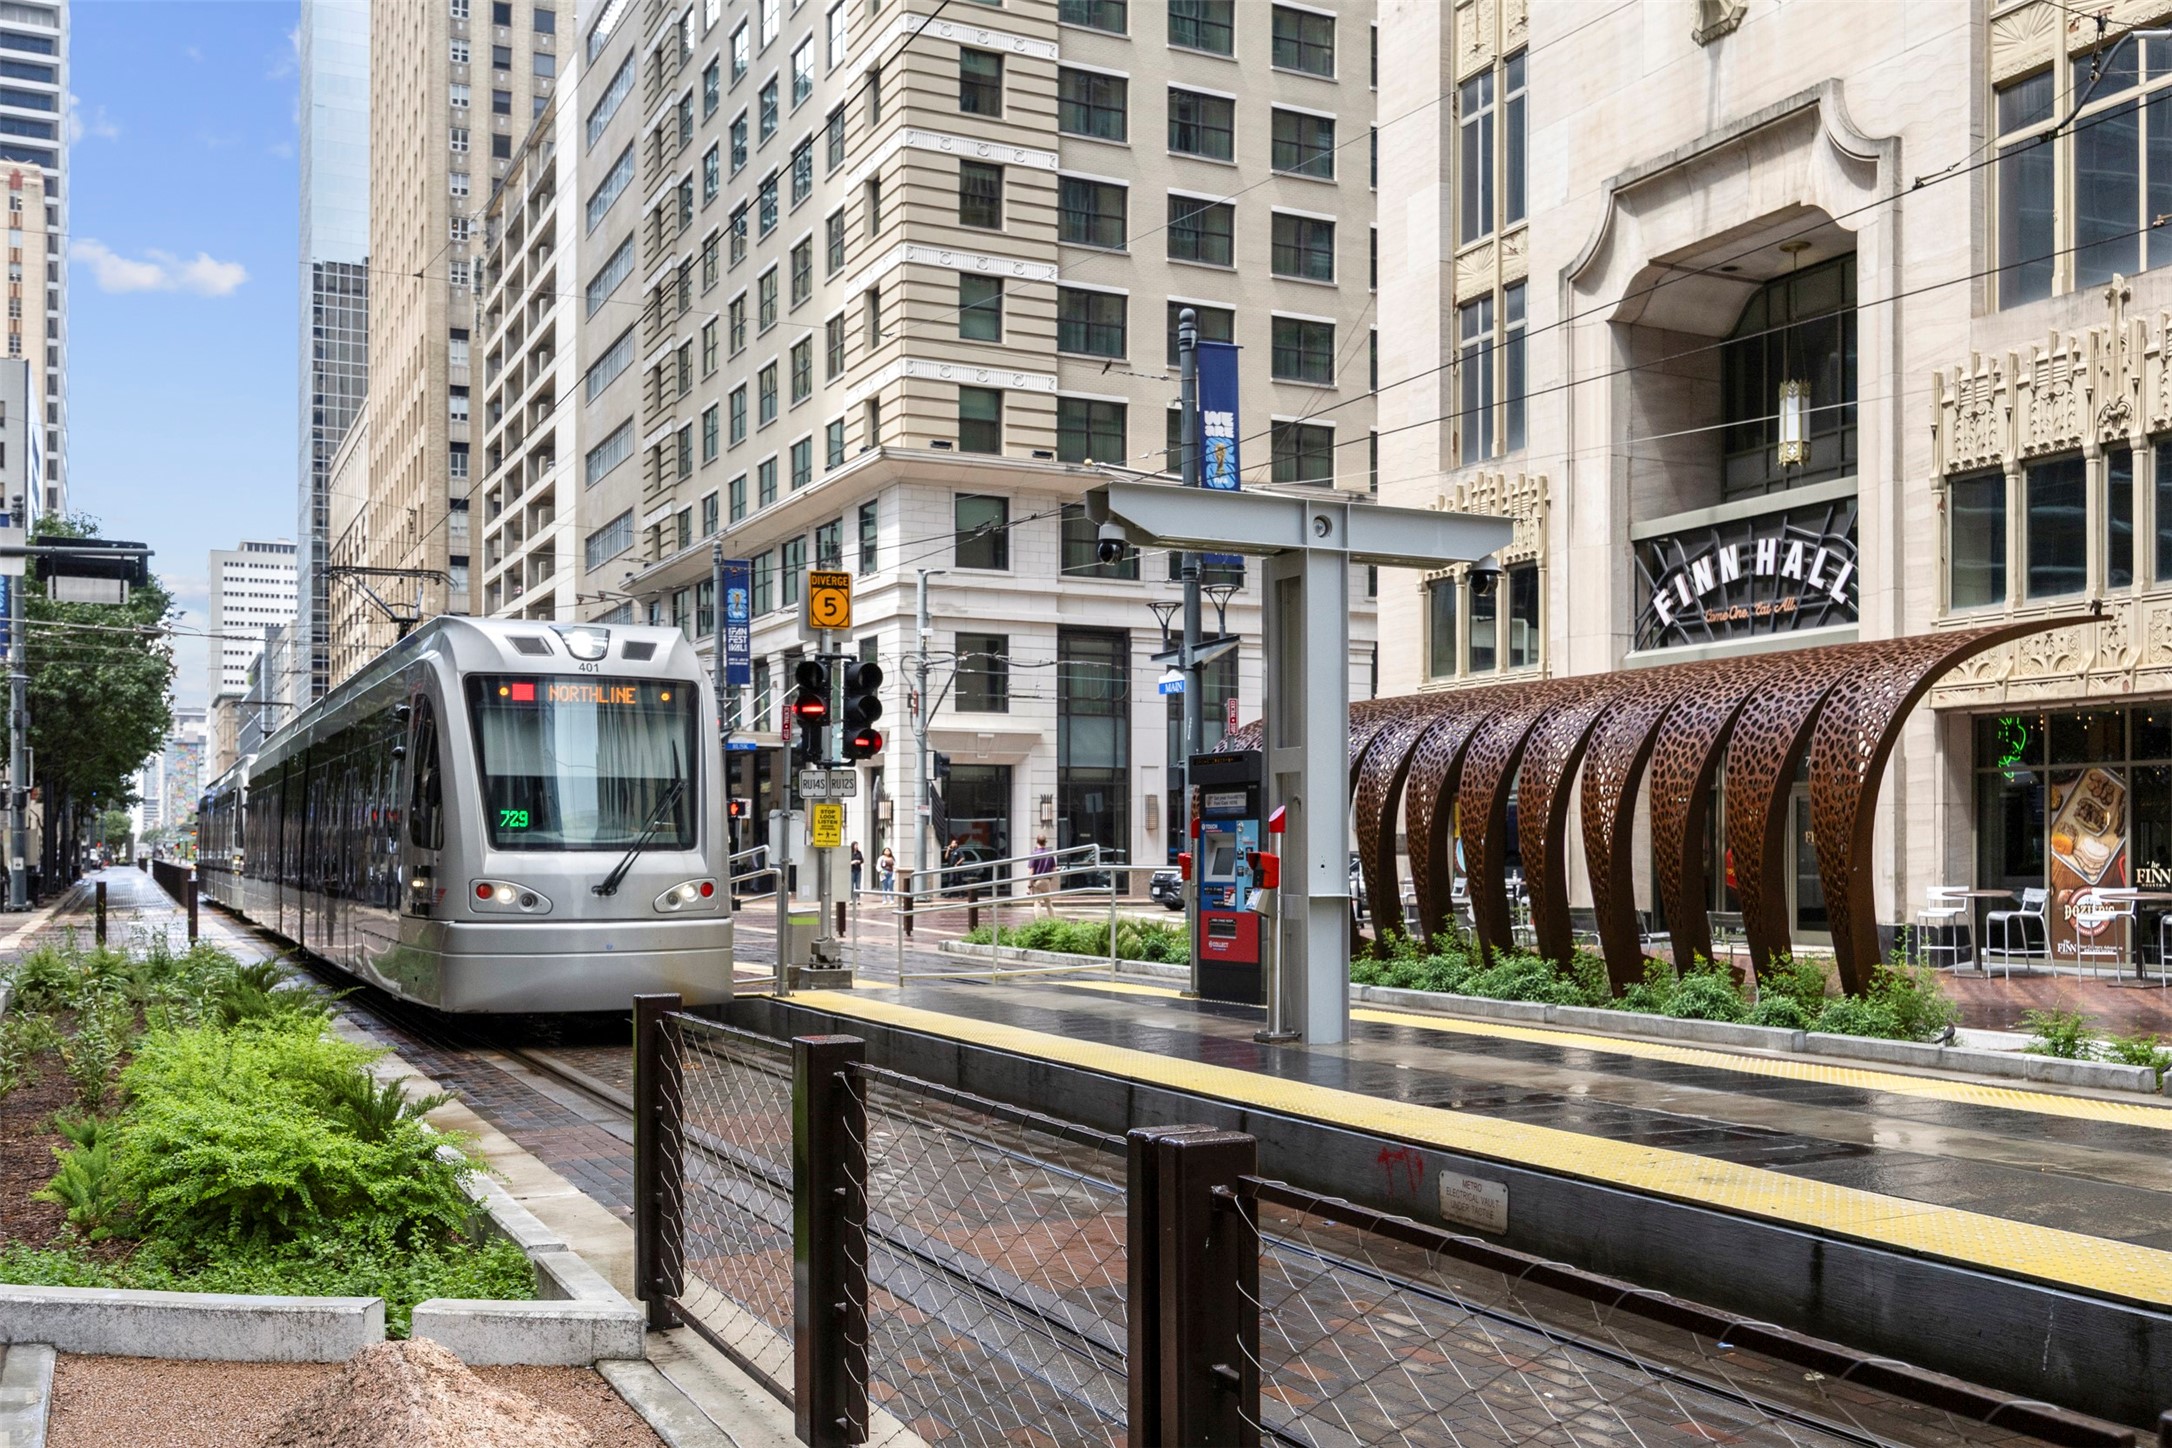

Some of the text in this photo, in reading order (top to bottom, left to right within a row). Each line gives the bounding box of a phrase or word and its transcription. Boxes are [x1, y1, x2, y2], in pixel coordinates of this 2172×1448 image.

[811, 575, 849, 586] DIVERGE
[1653, 538, 1853, 627] FINN HALL
[824, 597, 837, 616] 5
[1704, 607, 1729, 623] Come
[1754, 601, 1772, 616] Eat
[578, 663, 600, 672] 401
[549, 685, 636, 704] NORTHLINE
[1165, 682, 1183, 692] MAIN
[803, 779, 854, 789] RU14S RU12S
[500, 810, 529, 827] 729
[2136, 868, 2171, 884] FINN
[2057, 943, 2077, 953] FINN
[1462, 1179, 1482, 1193] METRO
[1446, 1186, 1499, 1209] ELECTRICAL VAULT
[1451, 1200, 1470, 1212] UNDER
